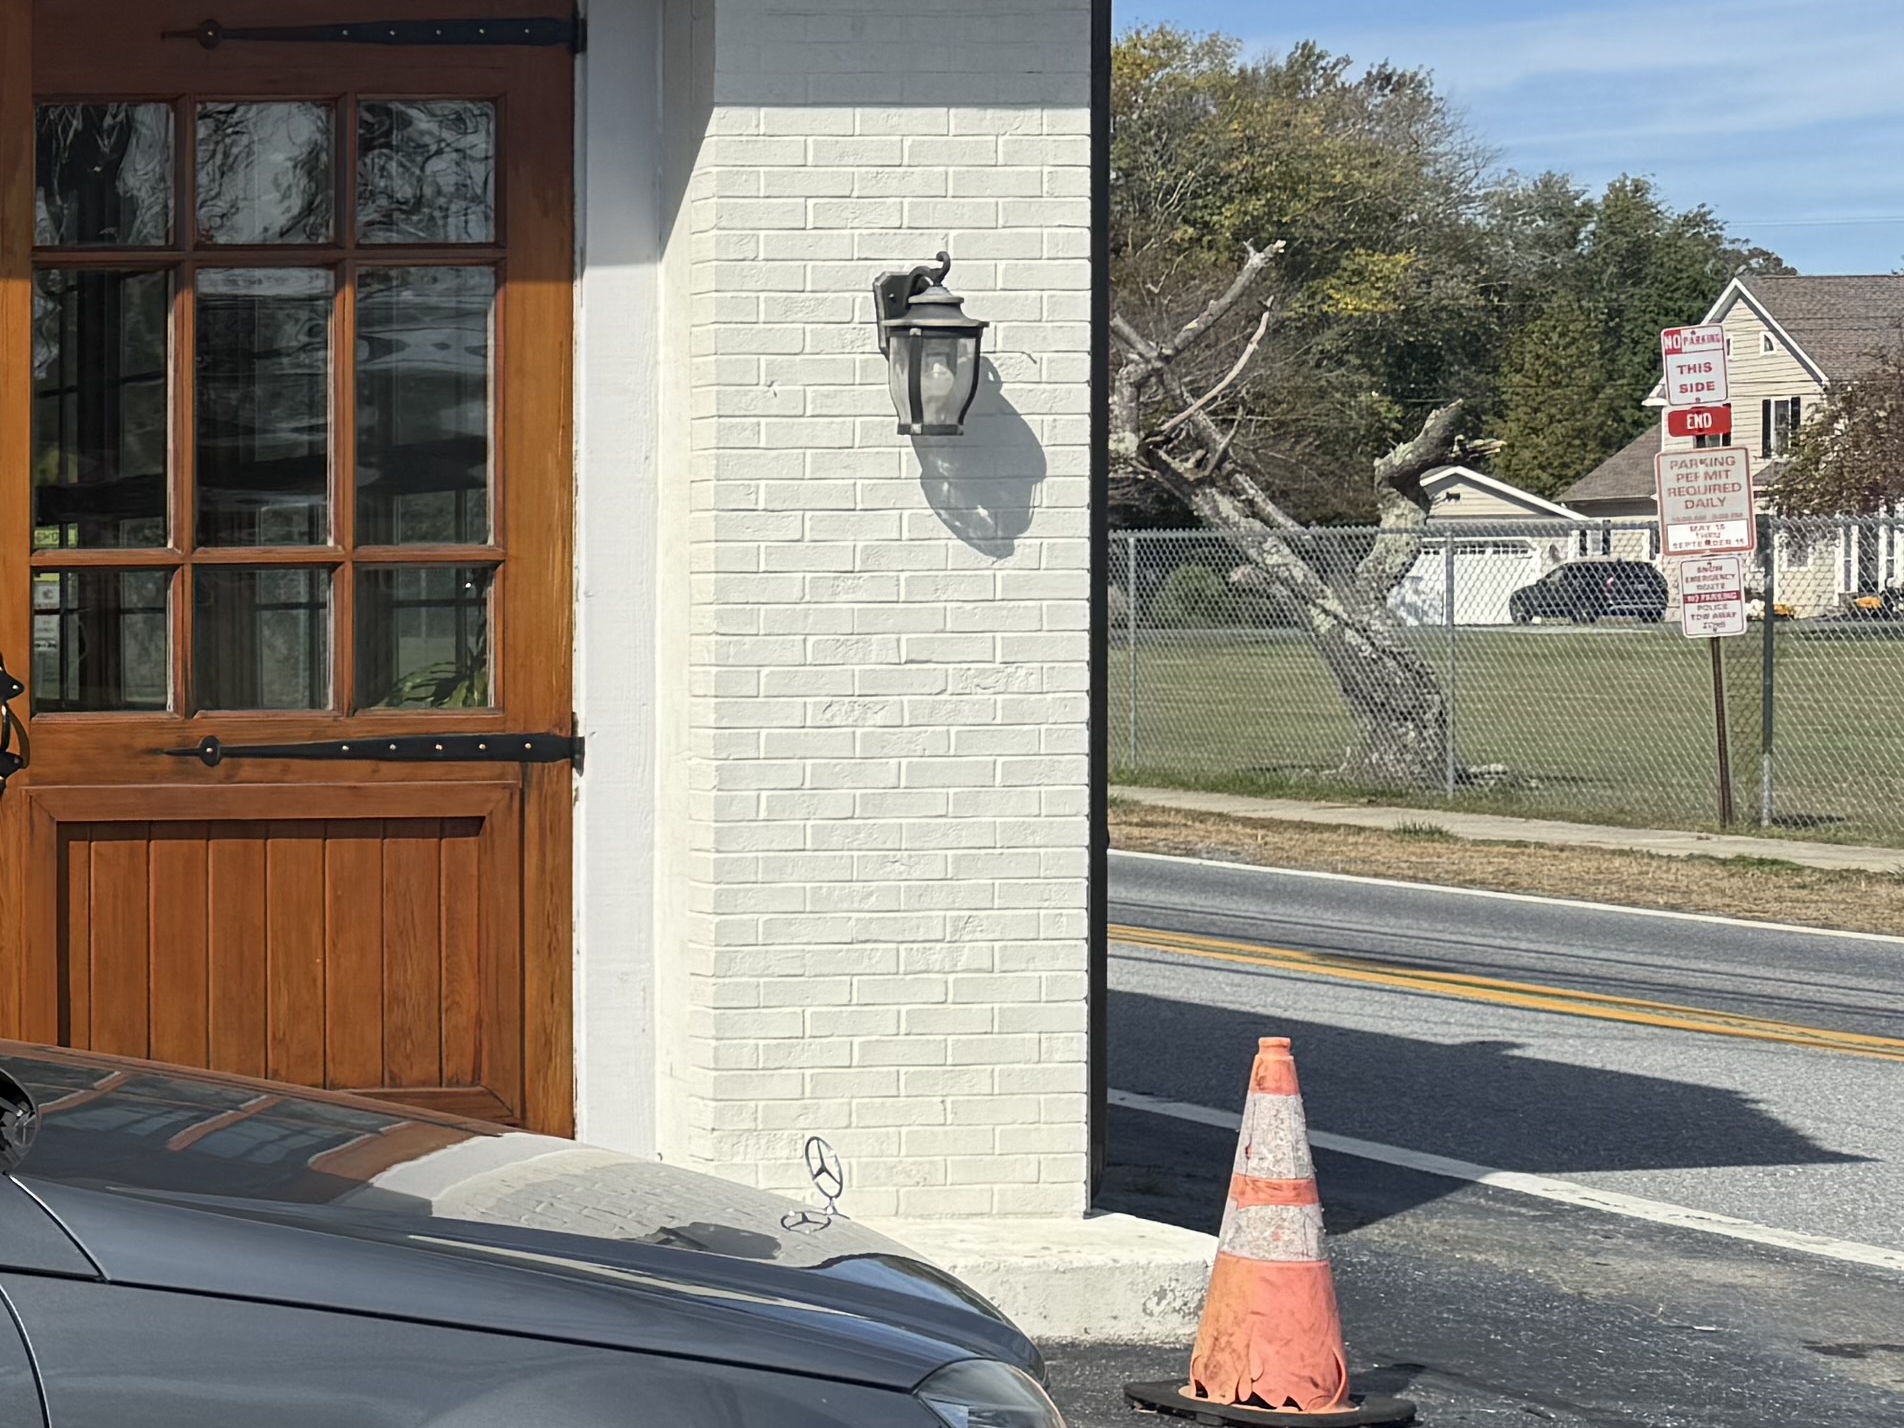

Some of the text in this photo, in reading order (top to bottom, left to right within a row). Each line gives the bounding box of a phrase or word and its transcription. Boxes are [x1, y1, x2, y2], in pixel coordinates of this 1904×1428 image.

[1664, 333, 1721, 350] NO PARKING
[1676, 361, 1713, 375] THIS
[1679, 380, 1716, 394] SIDE
[1686, 412, 1713, 430] END
[1670, 456, 1736, 471] PARKING
[1667, 482, 1742, 497] REQUIRED
[1684, 496, 1727, 510] DAILY
[1690, 524, 1711, 532] MAY
[1672, 539, 1732, 549] SEPTEBER
